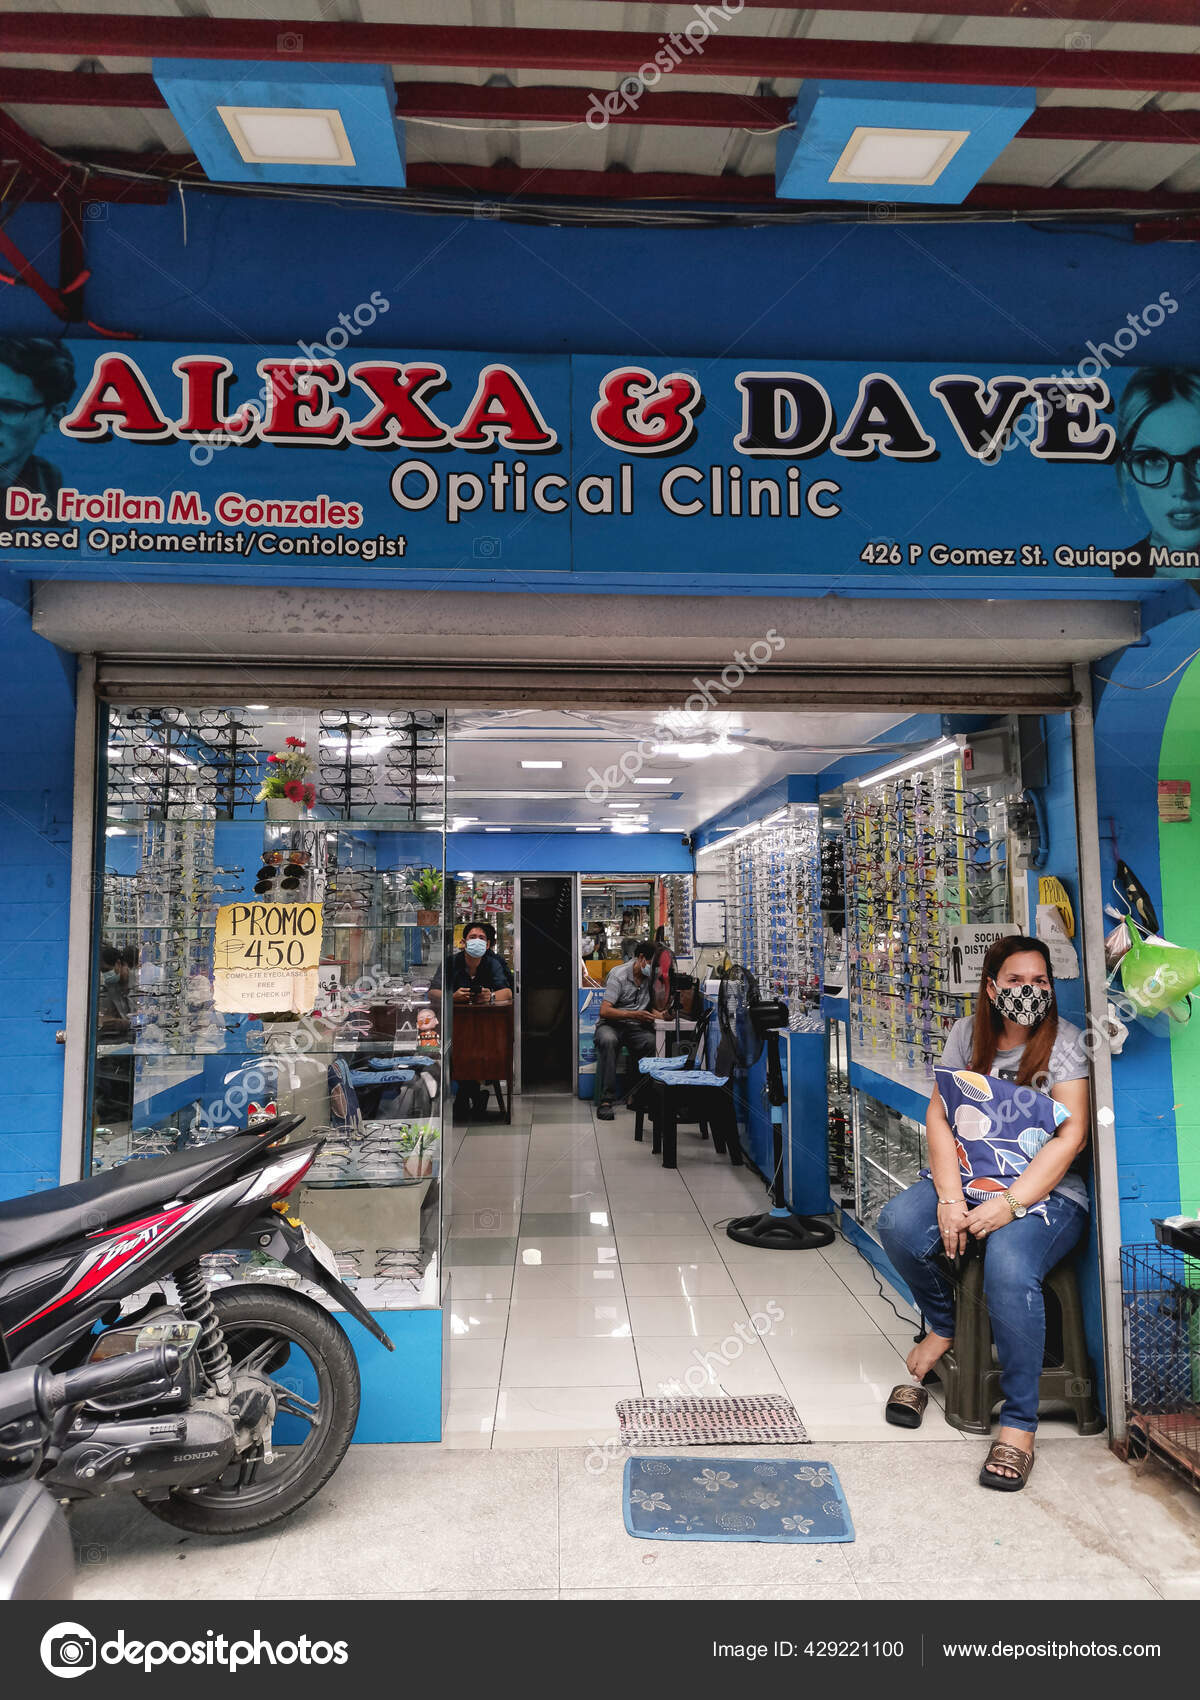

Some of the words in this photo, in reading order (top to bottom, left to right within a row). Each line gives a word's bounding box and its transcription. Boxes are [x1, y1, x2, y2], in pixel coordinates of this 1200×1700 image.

[60, 351, 558, 453] ALEXA
[590, 366, 701, 453] &
[734, 371, 1117, 461] DAVE
[389, 459, 633, 522] Optical
[660, 465, 842, 518] Clinic
[7, 487, 51, 520] Dr.
[58, 488, 163, 523] Froilan
[168, 491, 210, 524] M.
[215, 492, 363, 529] Gonzales
[0, 528, 79, 549] ensed
[88, 528, 407, 560] Optometrist/Contologist
[861, 543, 902, 564] 426
[909, 544, 922, 565] P
[929, 544, 1016, 565] Gomez
[1020, 545, 1048, 566] St.
[1054, 545, 1142, 570] Quiapo
[1149, 546, 1200, 566] Man
[227, 905, 316, 936] PROMO
[964, 944, 992, 955] DISTA
[173, 1450, 220, 1462] HONDA
